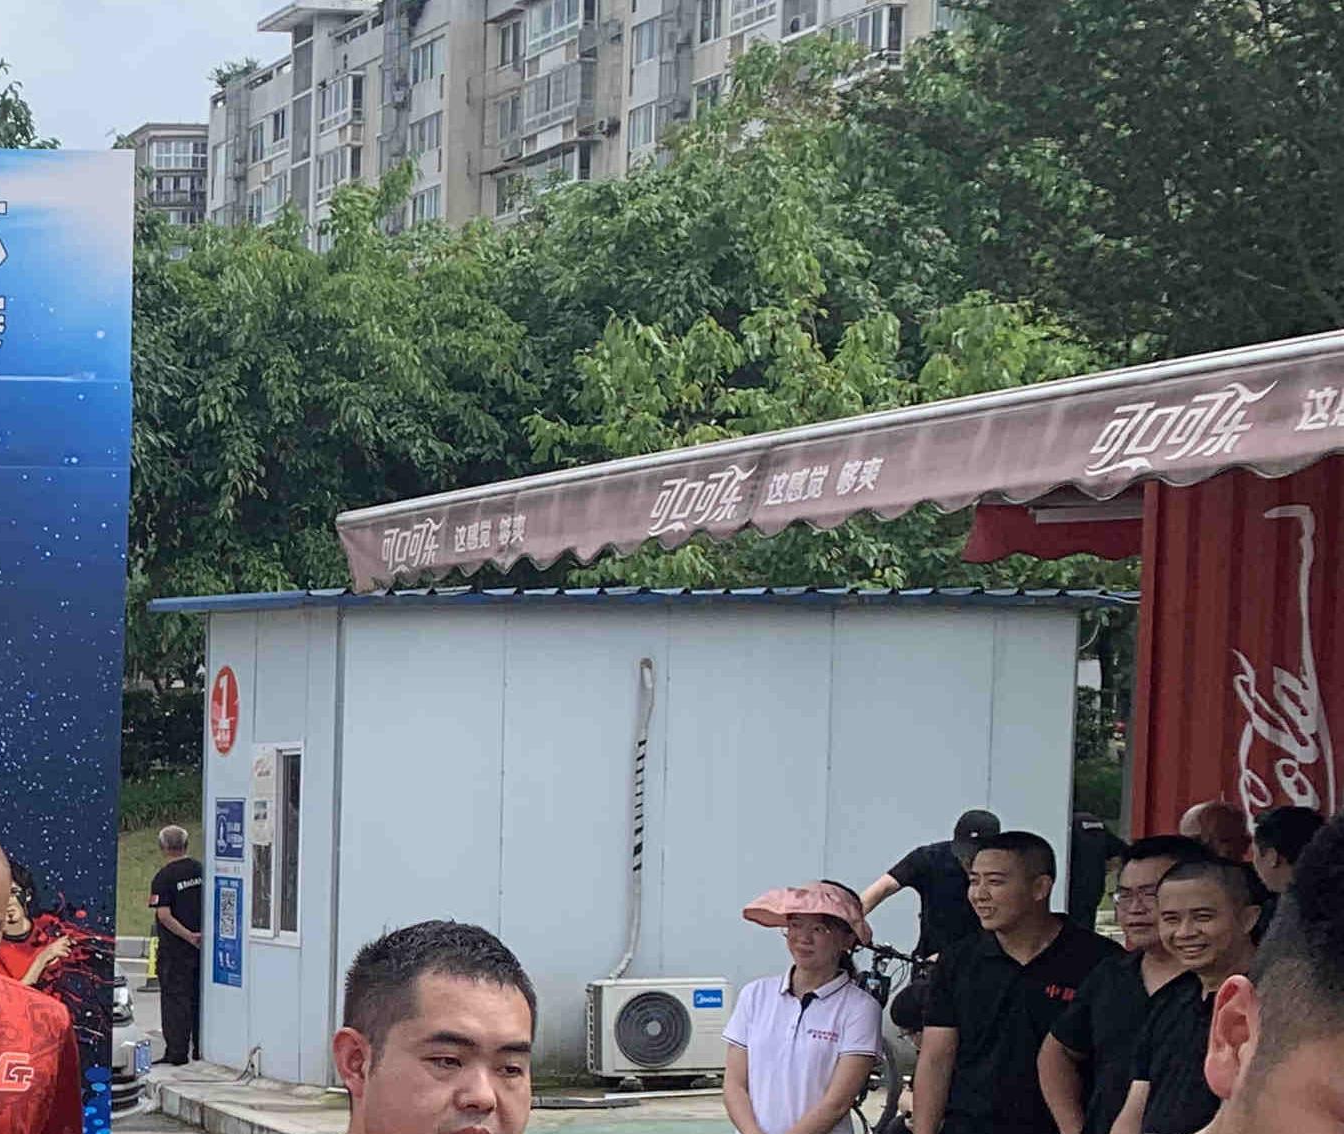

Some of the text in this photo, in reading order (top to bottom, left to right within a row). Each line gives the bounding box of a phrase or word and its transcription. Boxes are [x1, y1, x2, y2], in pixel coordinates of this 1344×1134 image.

[1085, 380, 1280, 477] 可口可乐
[648, 457, 884, 536] 可口可乐 这感觉 够爽
[382, 517, 445, 575] 可口可乐
